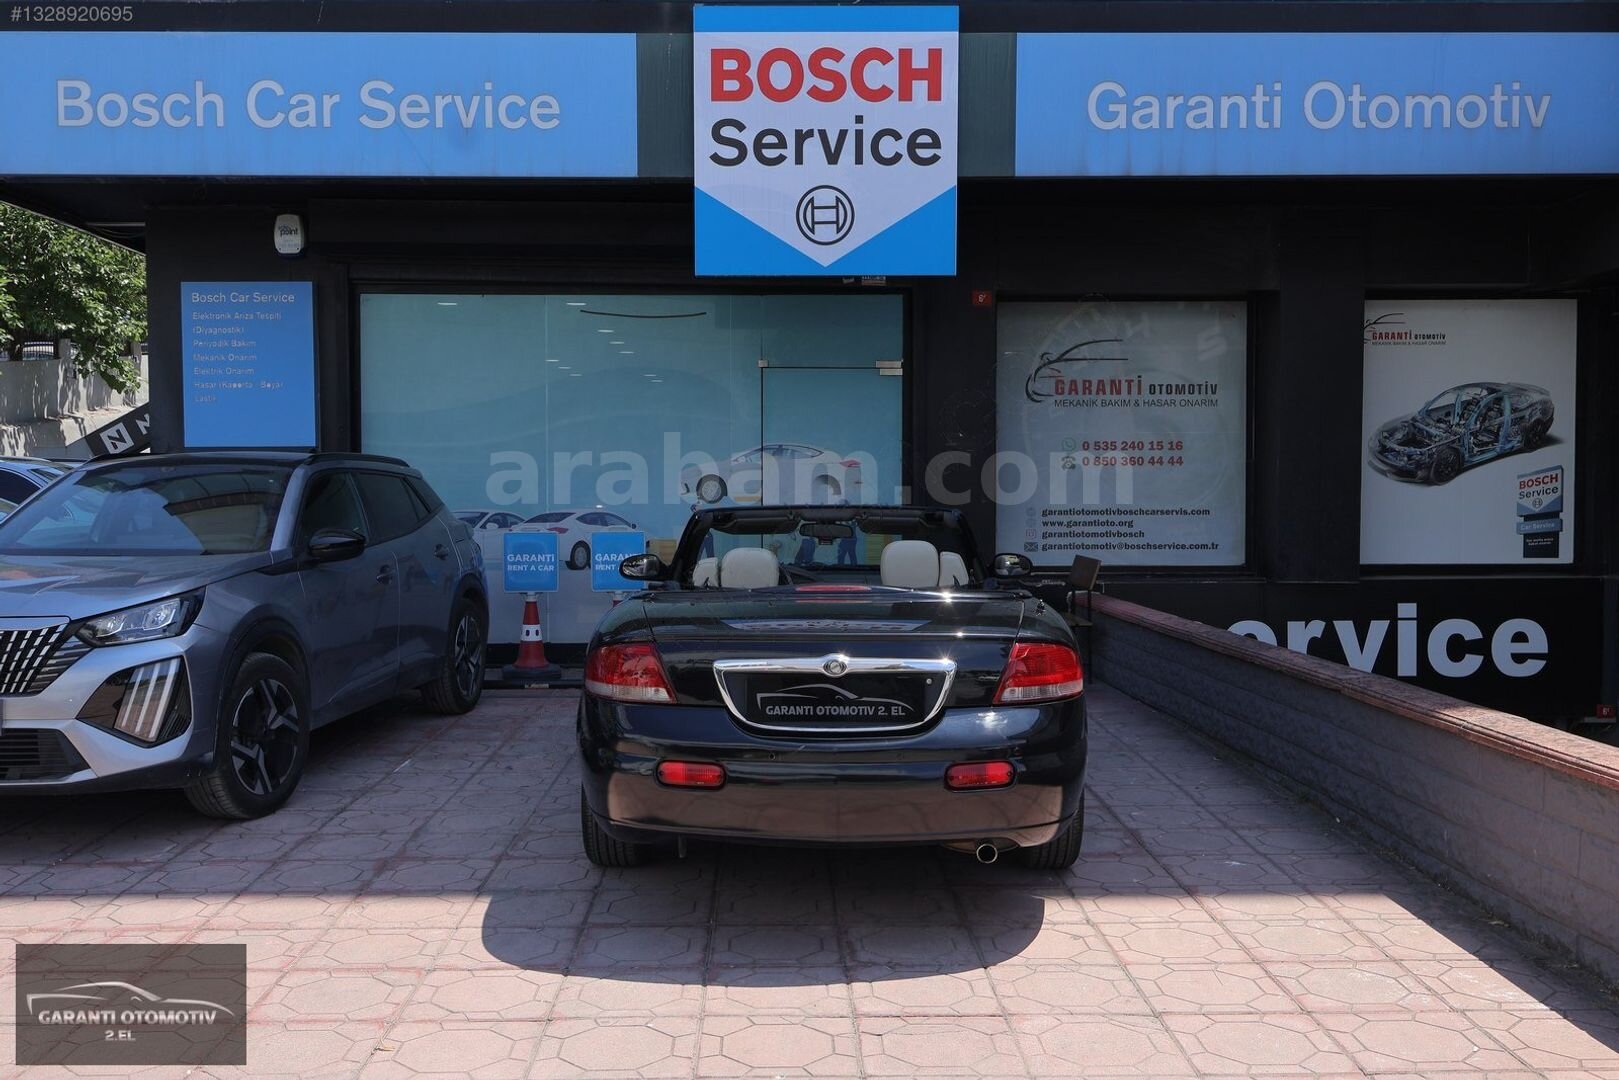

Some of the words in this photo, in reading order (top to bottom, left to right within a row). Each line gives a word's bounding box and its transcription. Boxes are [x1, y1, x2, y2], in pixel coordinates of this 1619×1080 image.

[710, 47, 942, 103] BOSCH
[55, 78, 224, 129] Bosch
[246, 78, 340, 129] Car
[358, 78, 562, 130] Service
[1086, 80, 1283, 130] Garanti
[1302, 80, 1552, 130] Otomotiv
[709, 115, 942, 167] Service
[191, 292, 226, 303] Bosch
[230, 292, 250, 303] Car
[252, 292, 295, 303] Service
[1101, 398, 1131, 408] BAKIM
[1133, 399, 1140, 408] &
[1143, 399, 1177, 408] HASAR
[1180, 399, 1218, 408] ONARIM
[1082, 441, 1090, 451] 0
[1093, 441, 1117, 451] 535
[1121, 441, 1145, 451] 240
[1148, 441, 1164, 451] 15
[1167, 441, 1184, 451] 16
[1082, 456, 1090, 466] 0
[1093, 456, 1117, 466] 850
[1121, 456, 1145, 466] 360
[1148, 456, 1164, 466] 44
[1167, 456, 1184, 466] 44
[1519, 473, 1559, 490] BOSCH
[1518, 486, 1559, 500] Service
[1041, 519, 1134, 529] www.garantioto.org
[1041, 530, 1145, 539] garantiotomotivbosch
[1041, 541, 1219, 552] garantiotomotiv@boschservice.com.tr
[507, 564, 528, 572] RENT
[530, 564, 536, 572] A
[538, 564, 555, 572] CAR
[765, 705, 814, 716] GARANTI
[816, 705, 875, 716] OTOMOTIV
[878, 705, 888, 716] 2.
[891, 705, 906, 716] EL
